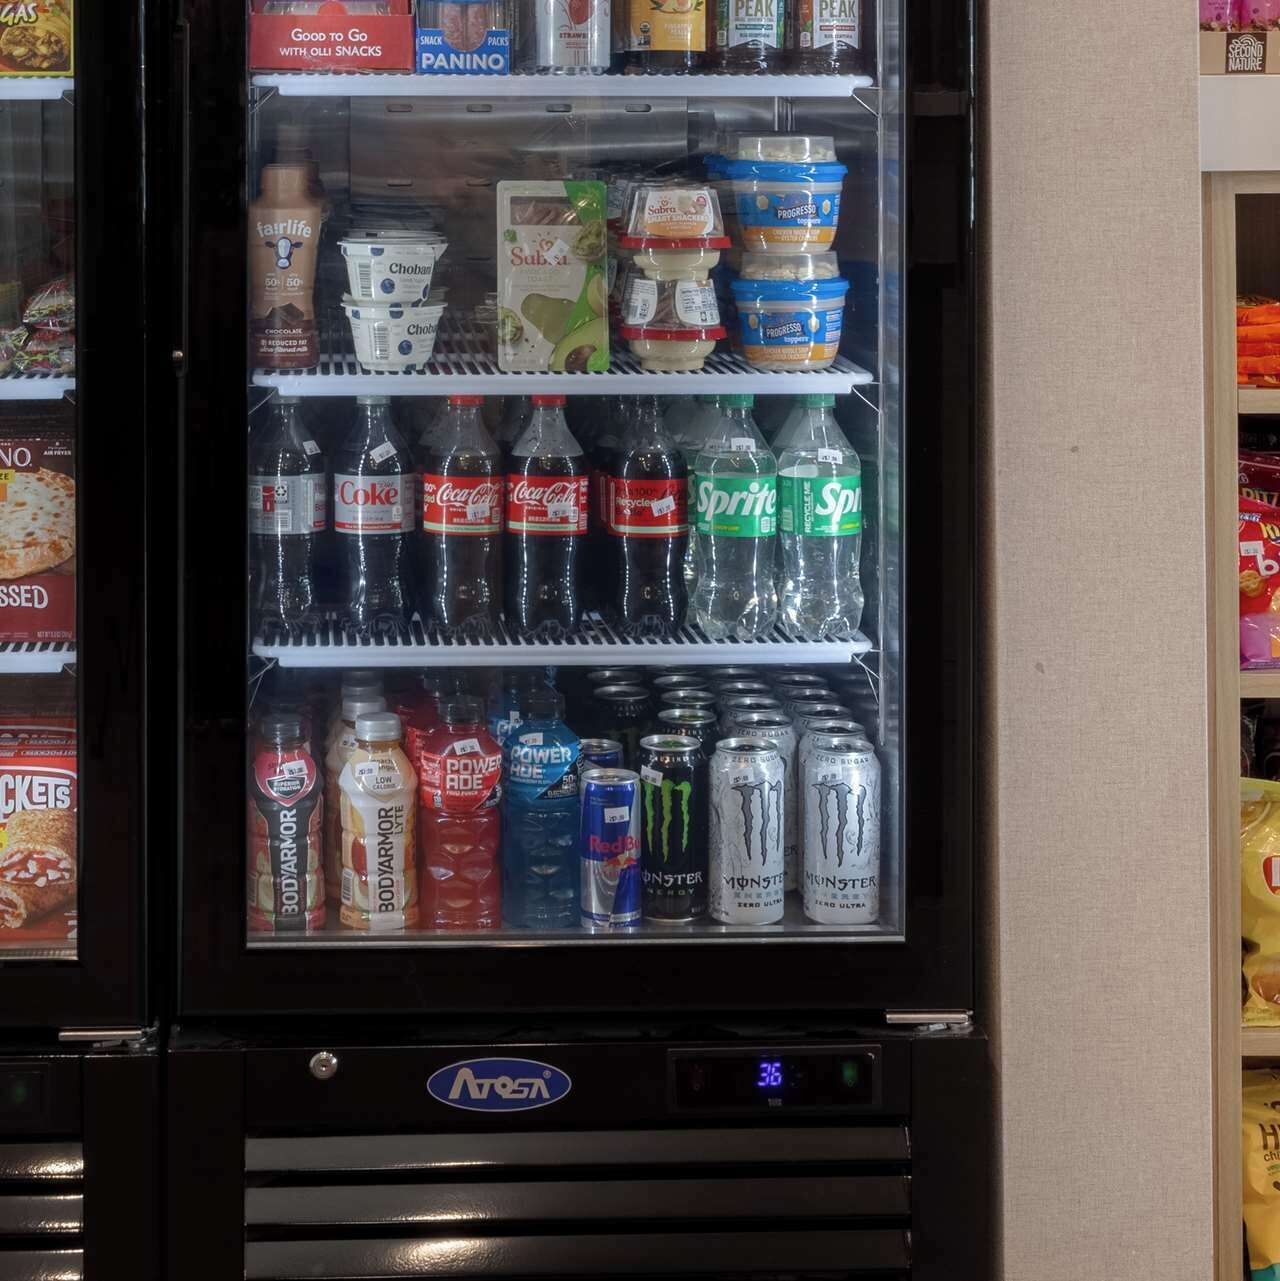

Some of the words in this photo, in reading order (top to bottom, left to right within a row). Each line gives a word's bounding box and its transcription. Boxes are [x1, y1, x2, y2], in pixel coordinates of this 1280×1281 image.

[735, 0, 774, 17] PEAK
[819, 0, 855, 17] PEAK
[420, 36, 442, 46] SNACK
[488, 36, 509, 46] PACKS
[1228, 39, 1263, 58] SECOND
[422, 53, 504, 70] PANINO
[1228, 57, 1262, 71] NATURE
[777, 205, 817, 219] PROGRESSO
[257, 220, 312, 238] fairlife
[766, 323, 802, 337] PROGRESSO
[340, 480, 399, 506] Coke
[436, 482, 499, 506] Coca-Cola
[513, 480, 577, 506] Coca-Cola
[696, 482, 776, 521] Sprite
[511, 746, 571, 763] POWER
[446, 756, 501, 774] POWER
[376, 776, 392, 784] LOW
[446, 775, 482, 789] ADE
[395, 805, 404, 834] LYTE
[280, 809, 299, 915] BODYARMOR
[378, 806, 394, 913] BODYARMOR
[806, 874, 877, 891] MONSTER
[757, 1063, 782, 1086] 36
